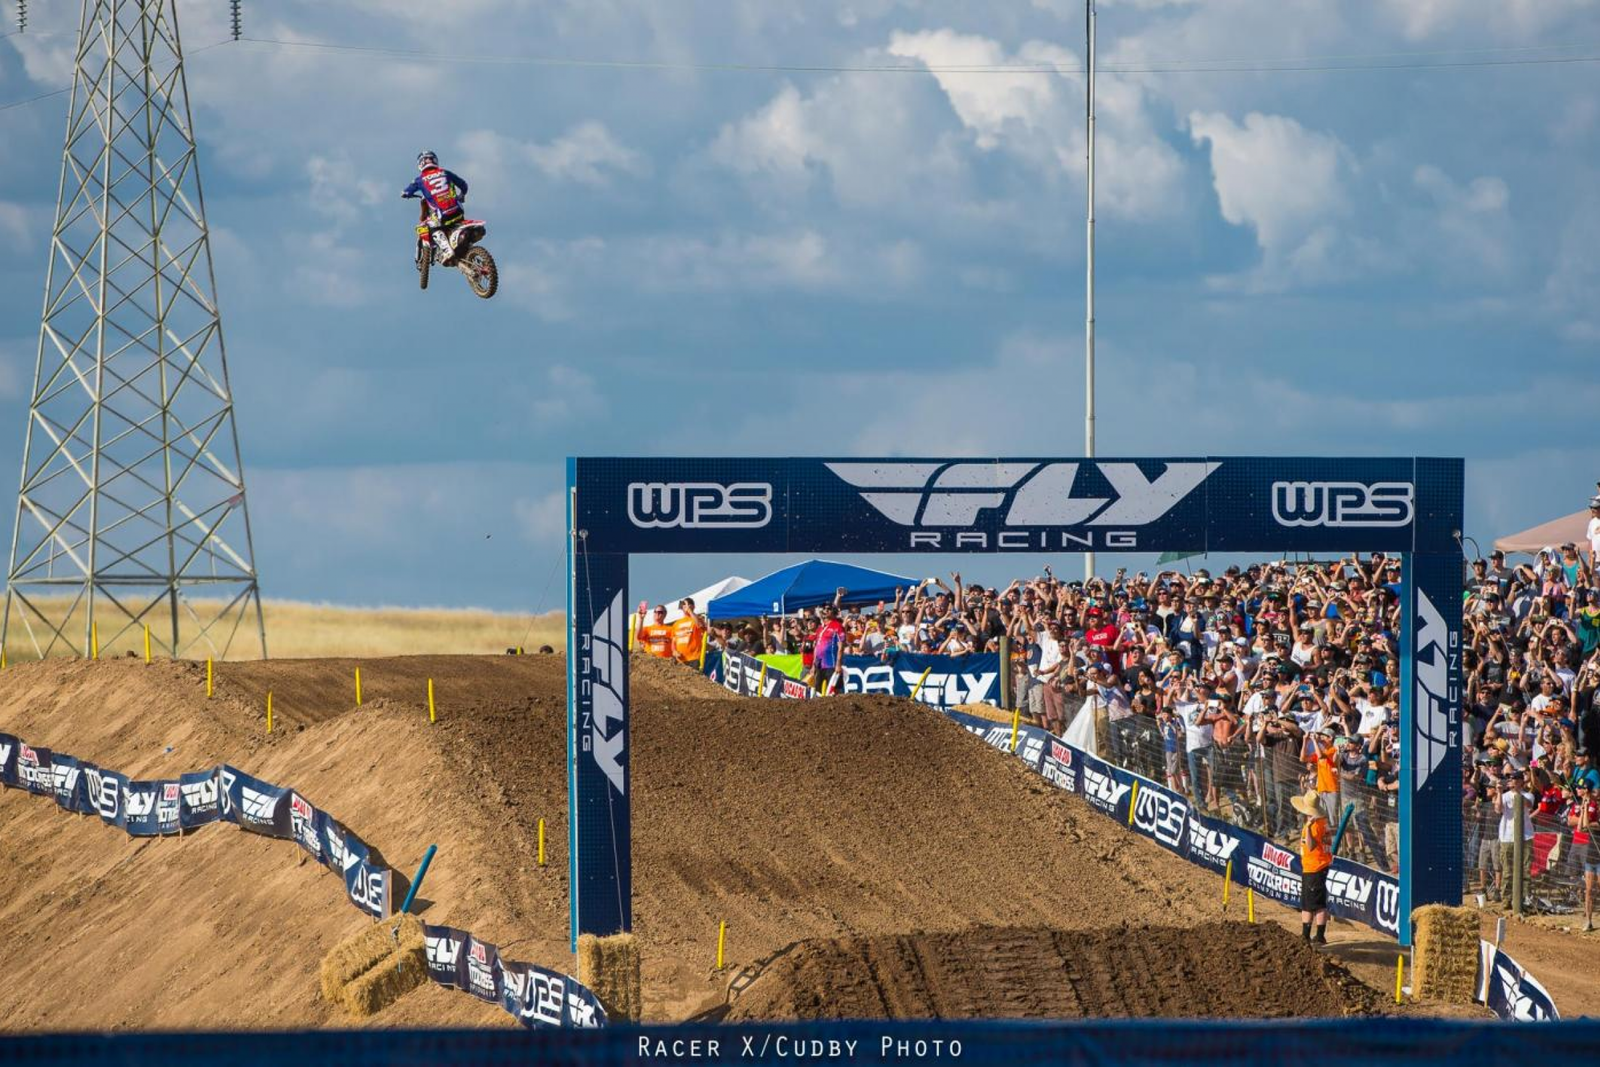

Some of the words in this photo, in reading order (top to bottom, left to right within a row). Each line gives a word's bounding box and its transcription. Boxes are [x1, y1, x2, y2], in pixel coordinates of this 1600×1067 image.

[429, 177, 449, 195] 3
[627, 482, 772, 529] WPS
[823, 462, 1224, 526] FLY
[1271, 481, 1414, 527] WPS
[910, 531, 1137, 548] RACING
[581, 633, 591, 752] RACING
[898, 671, 998, 705] FLY
[1449, 630, 1458, 748] RACING
[1083, 765, 1131, 805] FLY
[1134, 786, 1187, 847] WPS
[1189, 817, 1241, 859] FLY
[1191, 846, 1227, 867] RACING
[1325, 869, 1373, 904] FLY
[1328, 895, 1366, 911] RACING
